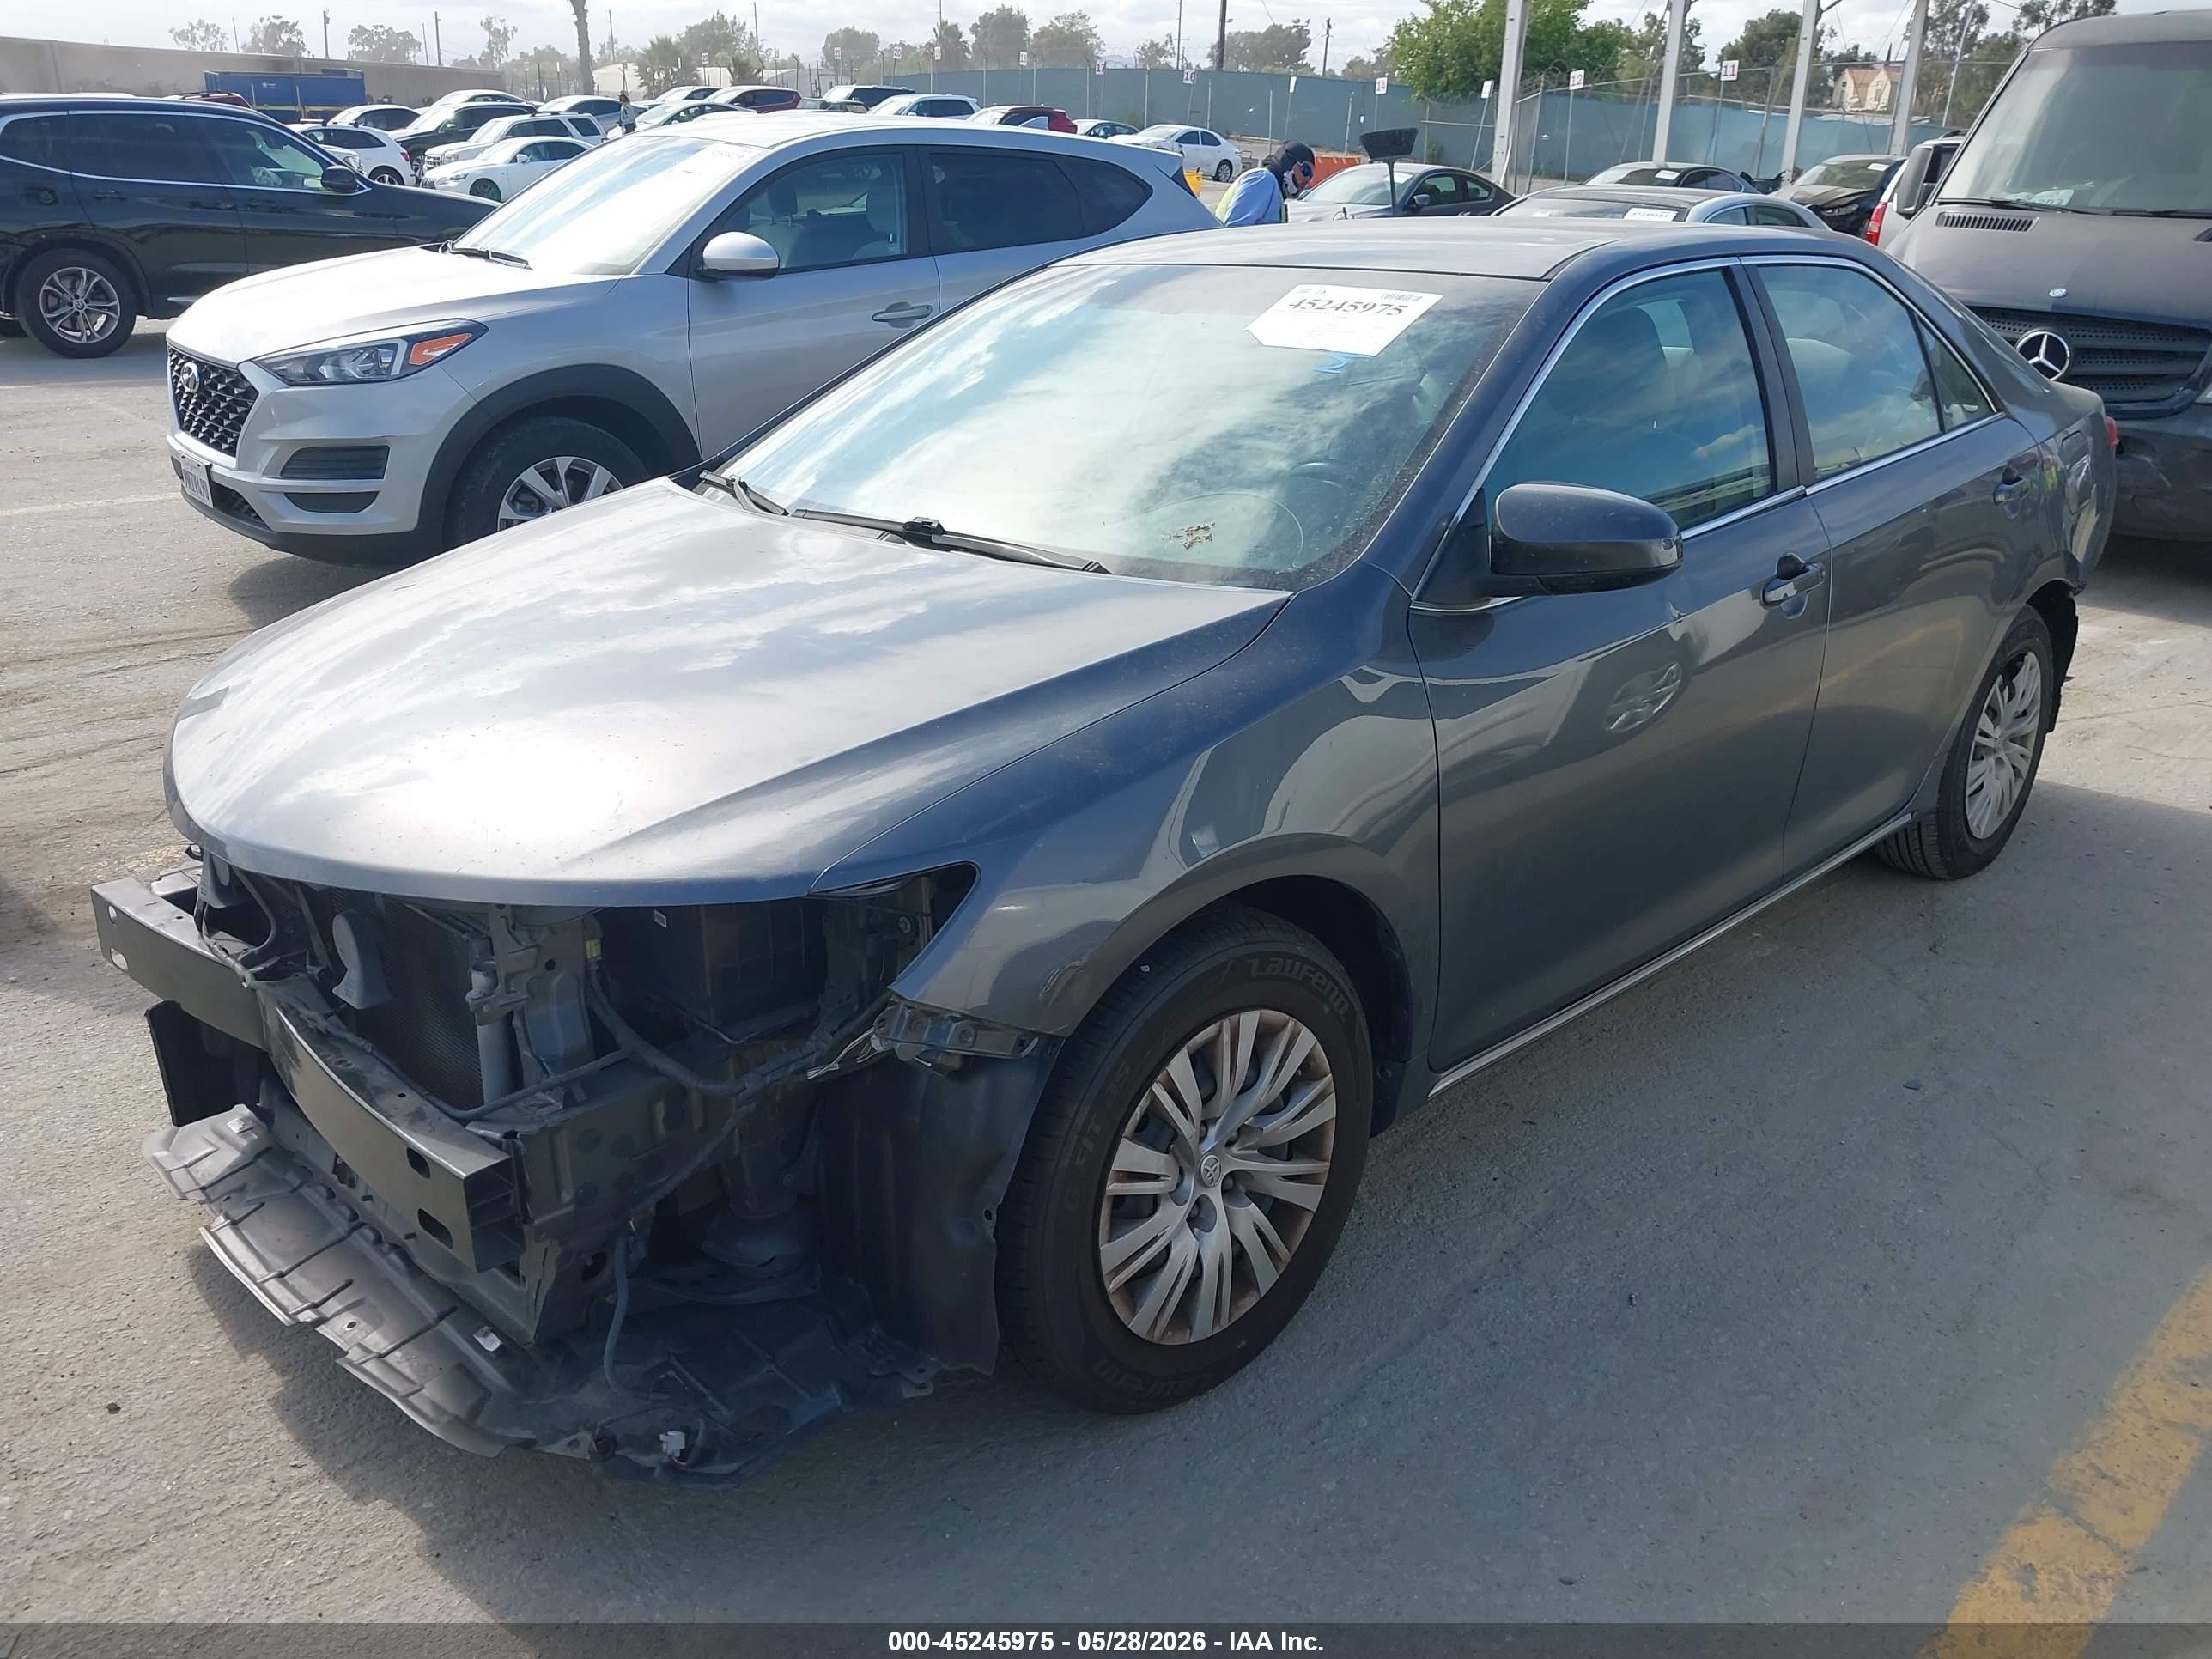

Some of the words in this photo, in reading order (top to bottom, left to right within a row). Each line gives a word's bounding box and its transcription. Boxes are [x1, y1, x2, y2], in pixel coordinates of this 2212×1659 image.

[1096, 61, 1106, 73] 17
[1722, 64, 1735, 76] 11
[1571, 74, 1583, 87] 12
[1288, 298, 1409, 316] 45245975
[1246, 956, 1349, 1016] Laufenn
